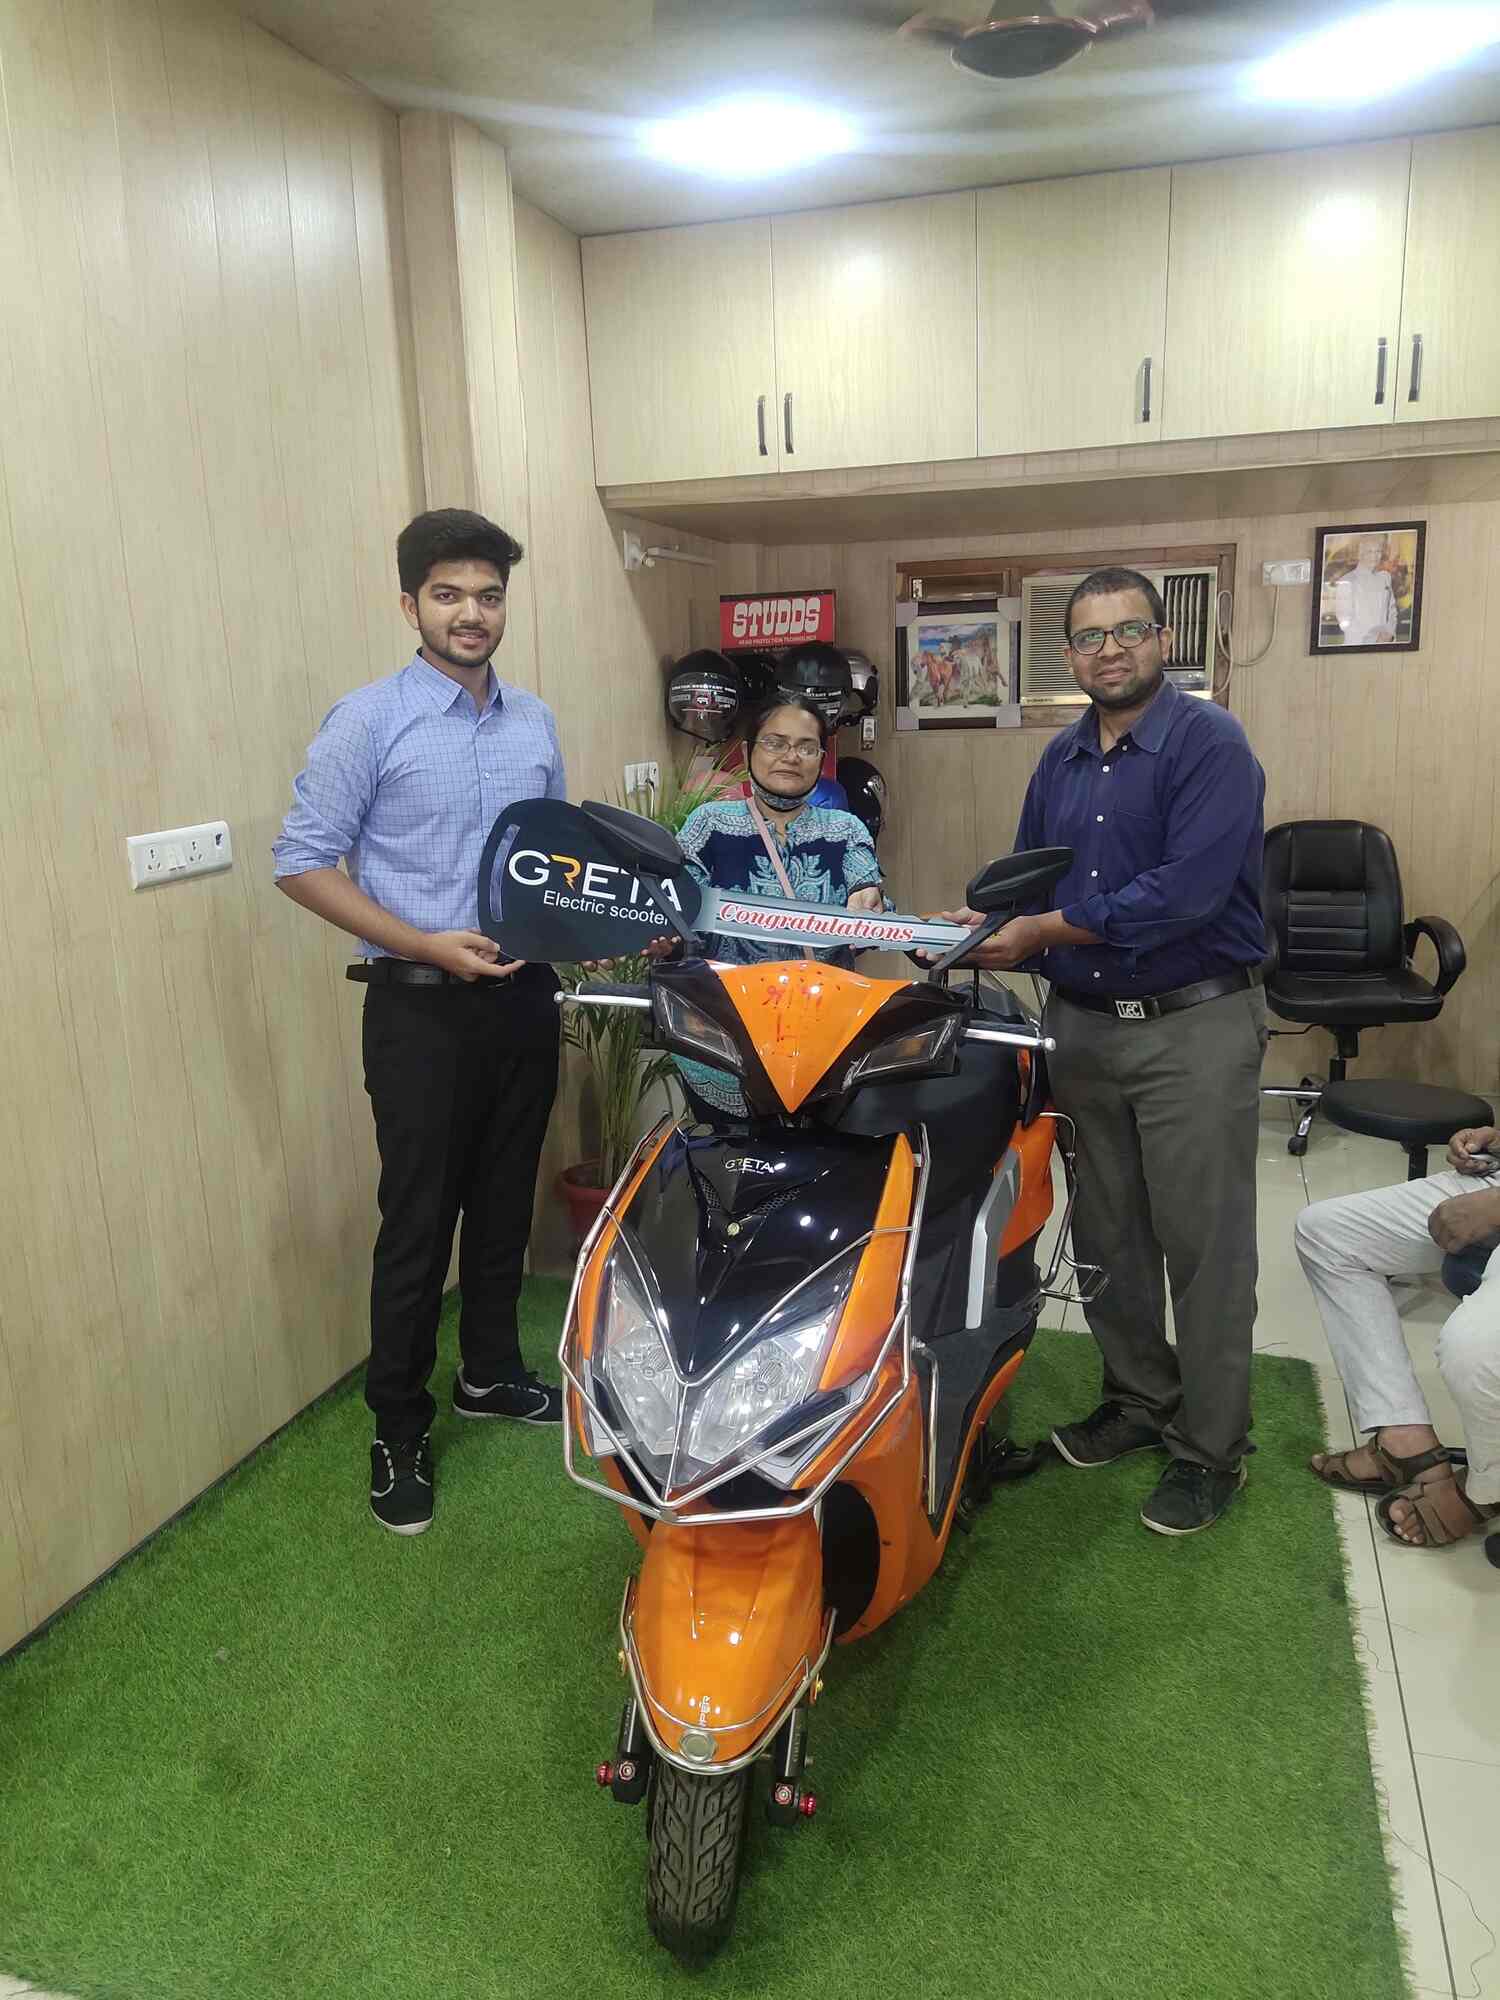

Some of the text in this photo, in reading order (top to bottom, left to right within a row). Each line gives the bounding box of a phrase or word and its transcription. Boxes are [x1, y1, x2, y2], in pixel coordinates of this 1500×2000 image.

[732, 597, 821, 638] STUDDS
[508, 849, 683, 912] GRETA
[543, 890, 605, 915] Electric
[719, 902, 914, 942] Congratulations
[725, 1157, 773, 1172] GRETA
